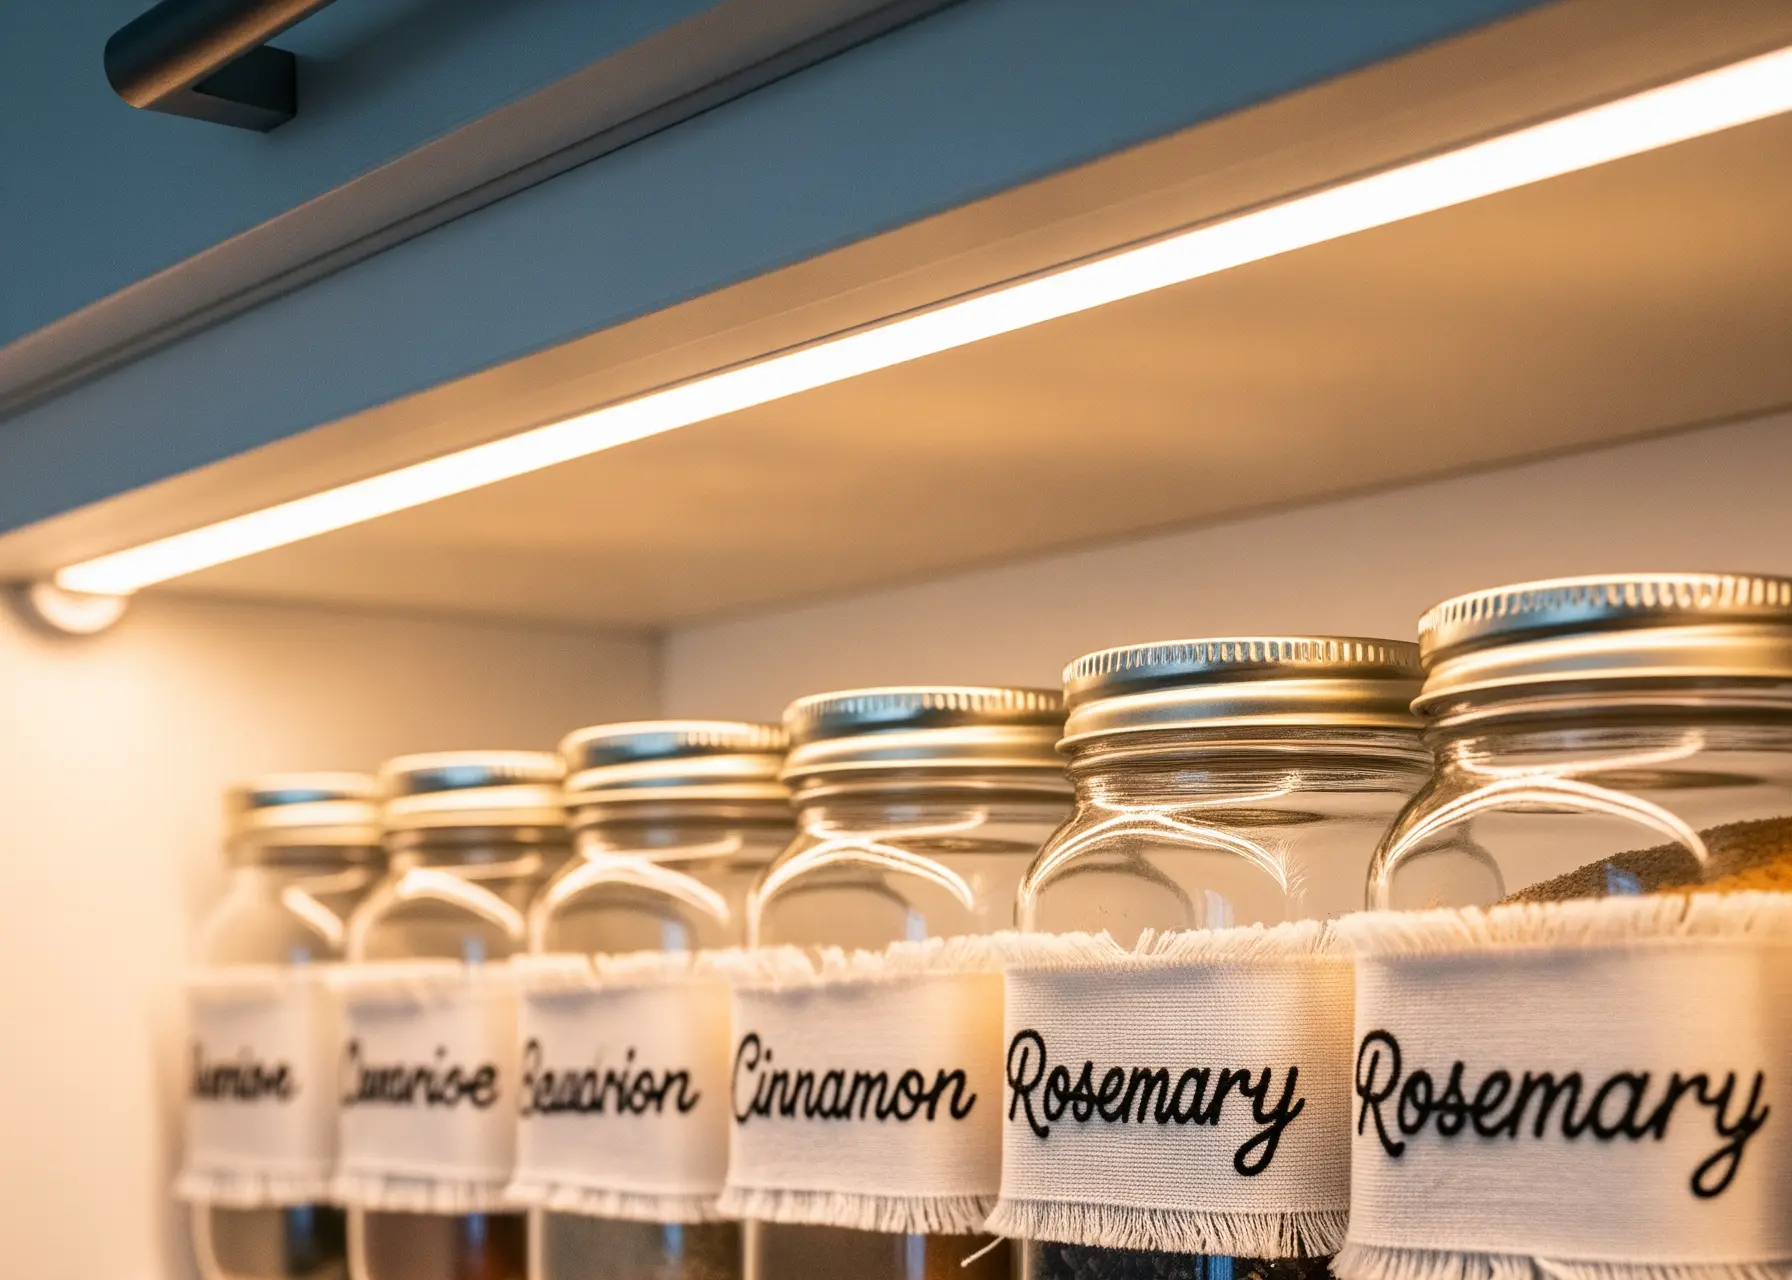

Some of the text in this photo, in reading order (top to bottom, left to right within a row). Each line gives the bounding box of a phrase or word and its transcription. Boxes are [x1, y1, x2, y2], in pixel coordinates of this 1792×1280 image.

[731, 1032, 977, 1124] Cinnamon
[1006, 1028, 1305, 1177] Rosemary
[1355, 1028, 1770, 1198] Rosemary
